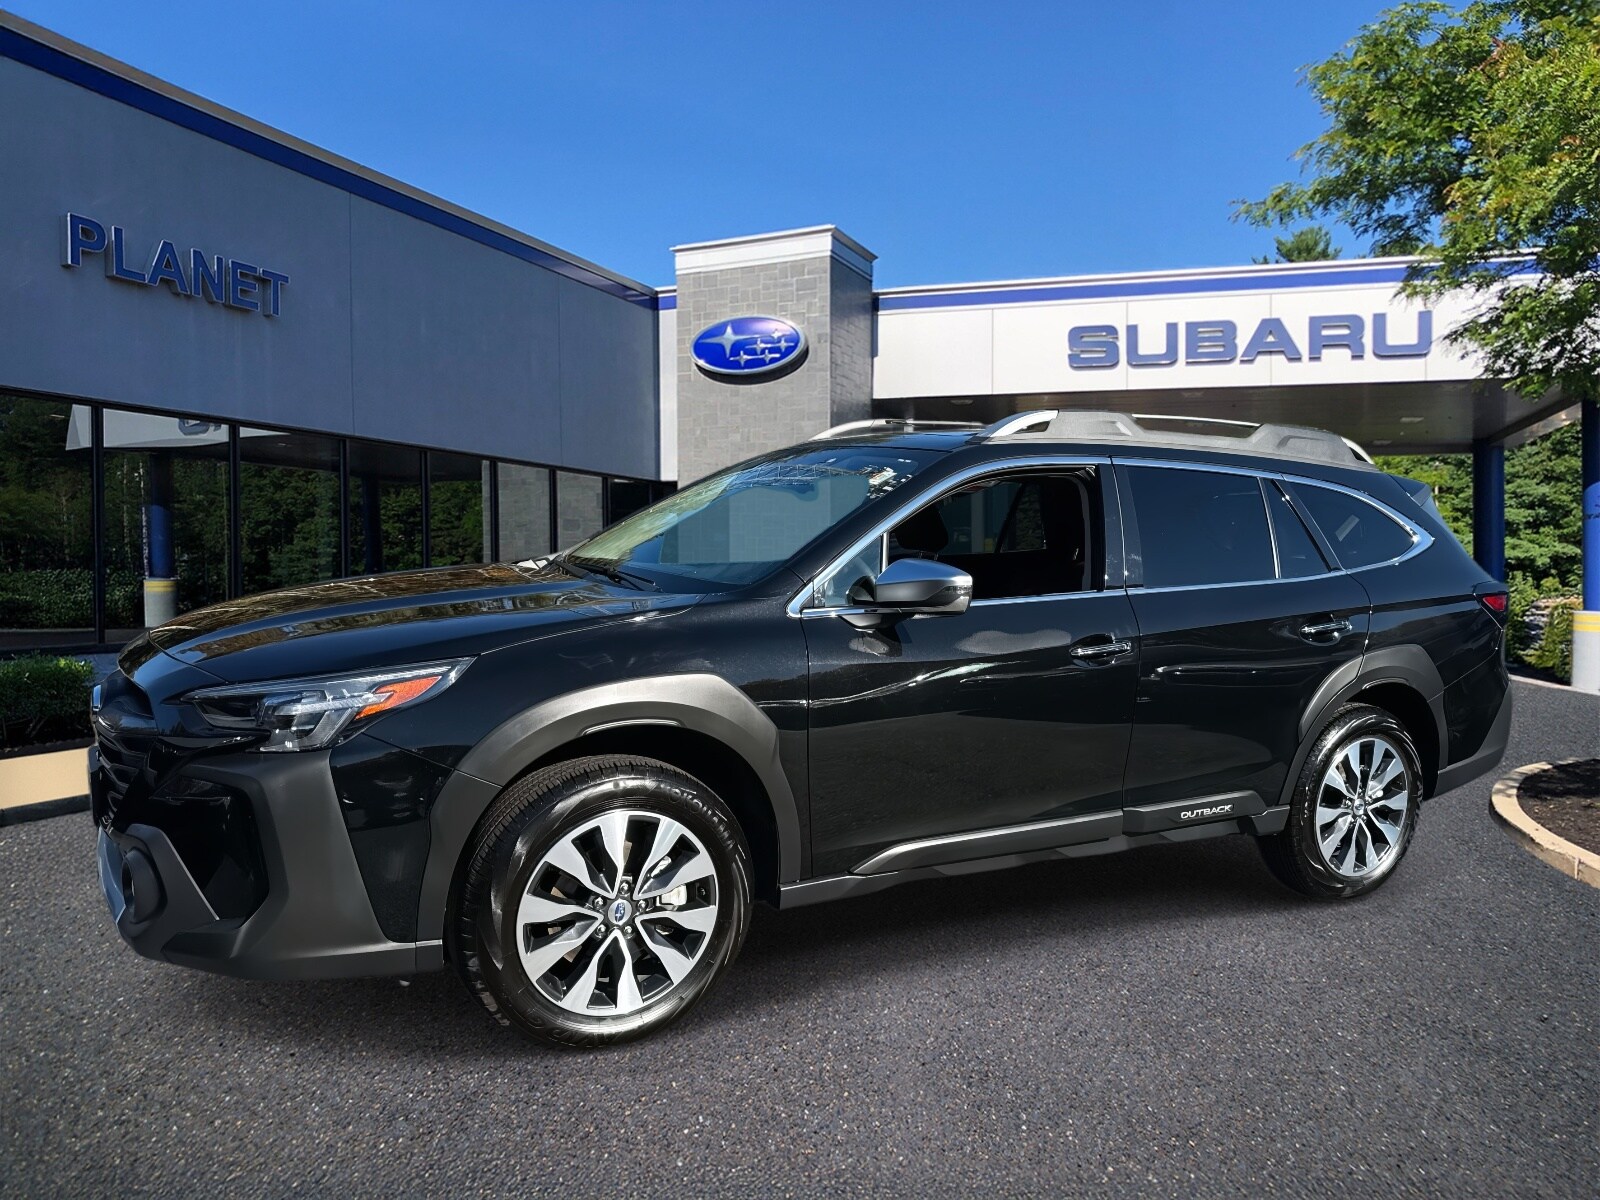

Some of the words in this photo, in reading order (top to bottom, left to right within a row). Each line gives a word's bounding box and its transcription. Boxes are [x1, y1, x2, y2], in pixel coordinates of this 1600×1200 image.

[64, 211, 290, 317] PLANET
[1067, 310, 1433, 368] SUBARU
[1180, 804, 1233, 819] OUTBACK
